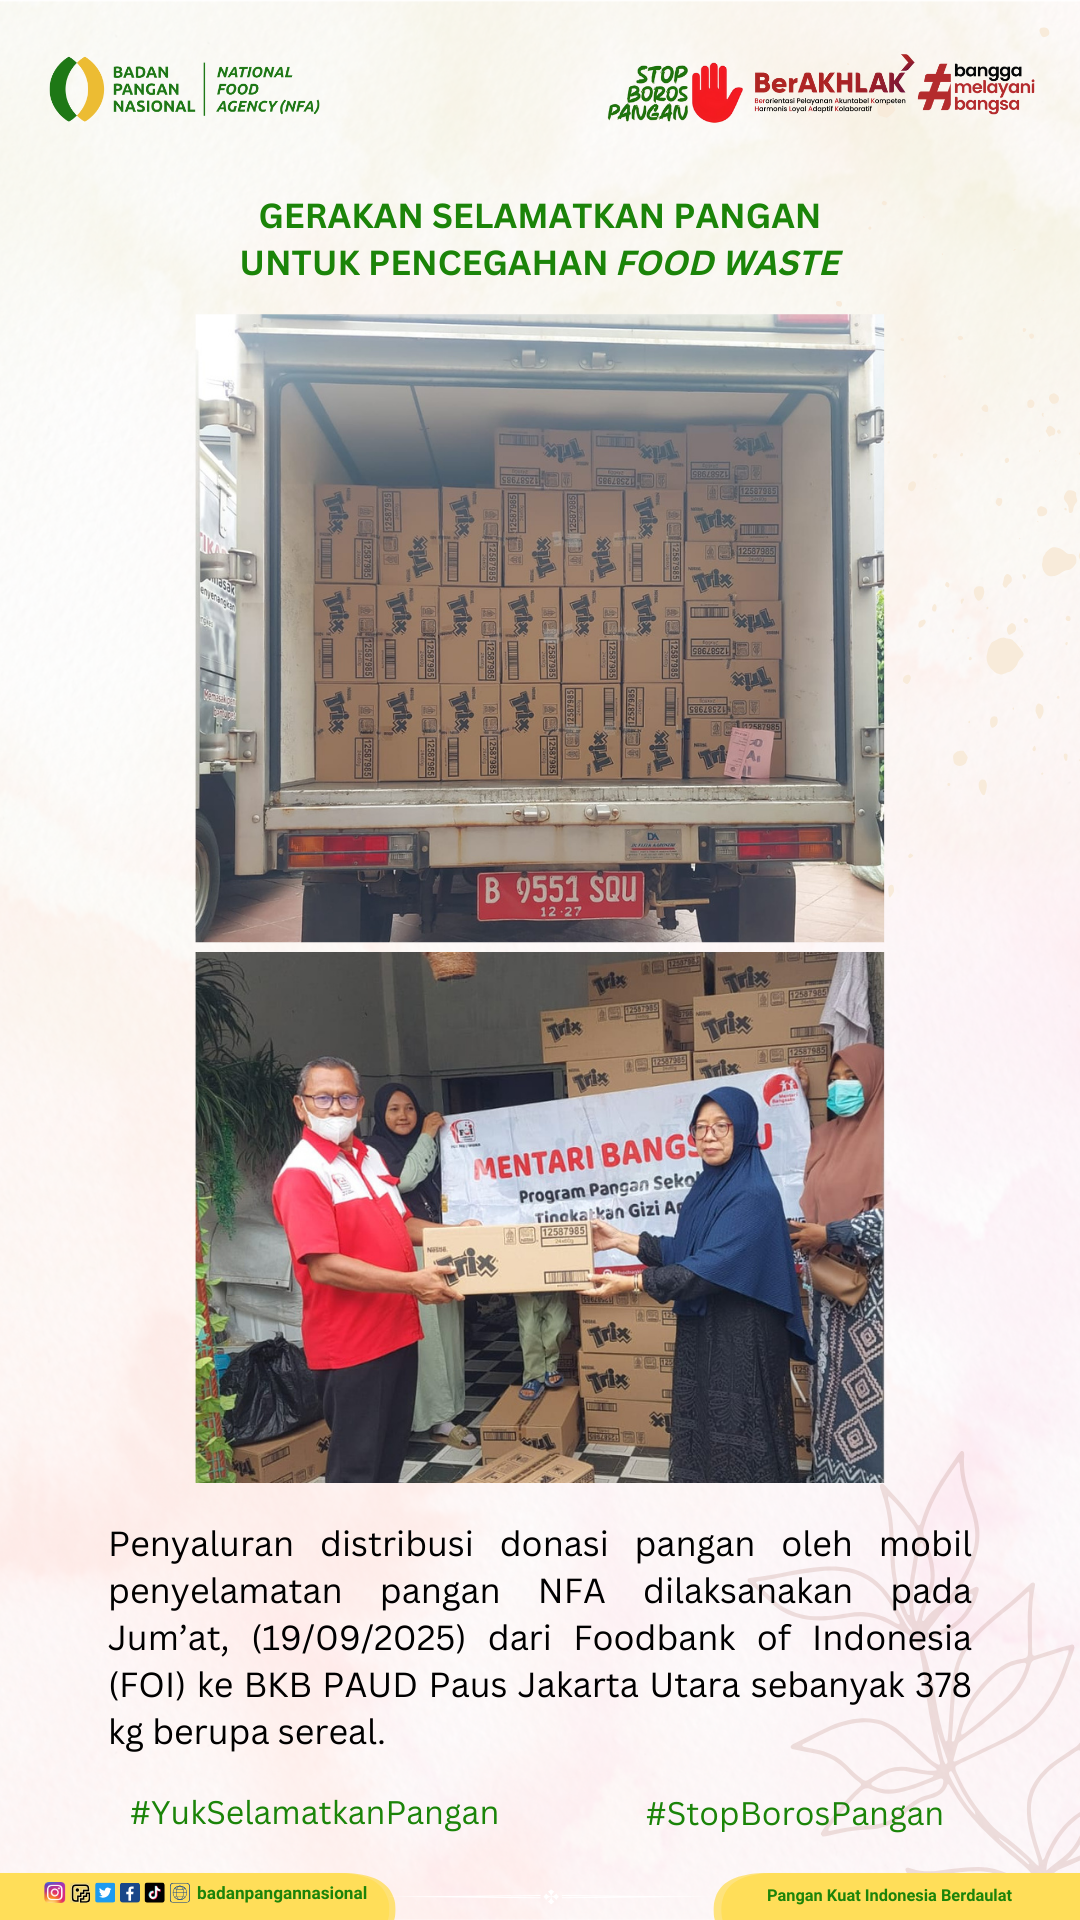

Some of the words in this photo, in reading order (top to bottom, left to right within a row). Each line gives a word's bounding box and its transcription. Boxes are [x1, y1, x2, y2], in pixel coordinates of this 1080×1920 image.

[543, 437, 585, 463] Trix
[639, 439, 680, 464] Trix
[734, 431, 774, 457] Trix
[741, 487, 776, 495] 12587985
[322, 491, 349, 535] Trix
[384, 492, 392, 531] 12587985
[449, 495, 475, 538] Trix
[509, 494, 517, 532] 12587985
[569, 495, 577, 532] 12587985
[633, 496, 658, 539] Trix
[694, 509, 736, 534] Trix
[363, 540, 372, 578] 12587985
[408, 536, 434, 578] Trix
[488, 543, 497, 581] 12587985
[532, 537, 557, 579] Trix
[592, 537, 617, 579] Trix
[672, 543, 680, 580] 12587985
[738, 547, 774, 555] 12587985
[692, 569, 734, 593] Trix
[323, 590, 349, 634] Trix
[386, 592, 412, 635] Trix
[447, 594, 472, 637] Trix
[508, 594, 533, 637] Trix
[570, 594, 594, 637] Trix
[632, 594, 656, 637] Trix
[733, 608, 775, 633] Trix
[364, 639, 373, 677] 12587985
[426, 640, 435, 678] 12587985
[487, 642, 495, 679] 12587985
[608, 641, 616, 679] 12587985
[670, 641, 679, 678] 12587985
[730, 666, 772, 691] Trix
[323, 691, 349, 734] Trix
[386, 691, 412, 734] Trix
[449, 691, 474, 733] Trix
[509, 691, 534, 733] Trix
[566, 689, 575, 726] 12587985
[627, 689, 636, 725] 12587985
[363, 739, 372, 777] 12587985
[427, 739, 435, 776] 12587985
[489, 737, 497, 774] 12587985
[548, 737, 557, 774] 12587985
[589, 730, 614, 773] Trix
[649, 730, 674, 773] Trix
[698, 745, 728, 770] Tri
[485, 877, 500, 904] B
[517, 875, 579, 904] 9551
[589, 875, 636, 903] SQU
[592, 972, 628, 996] Trix
[722, 966, 770, 993] Trix
[790, 988, 827, 999] 12587985
[547, 1017, 583, 1043] Trix
[701, 1010, 753, 1043] Trix
[700, 1059, 742, 1078] Trix
[789, 1046, 826, 1056] 12587985
[572, 1069, 610, 1093] Trix
[474, 1145, 594, 1180] MENTARI
[601, 1123, 773, 1168] BANGSU
[519, 1182, 586, 1204] Program
[590, 1177, 649, 1197] Pangan
[535, 1206, 625, 1224] Tingkatkan
[629, 1199, 660, 1217] Gizi
[543, 1226, 585, 1237] 12587985
[433, 1247, 499, 1287] Trix
[587, 1322, 632, 1348] Trix
[585, 1368, 630, 1394] Trix
